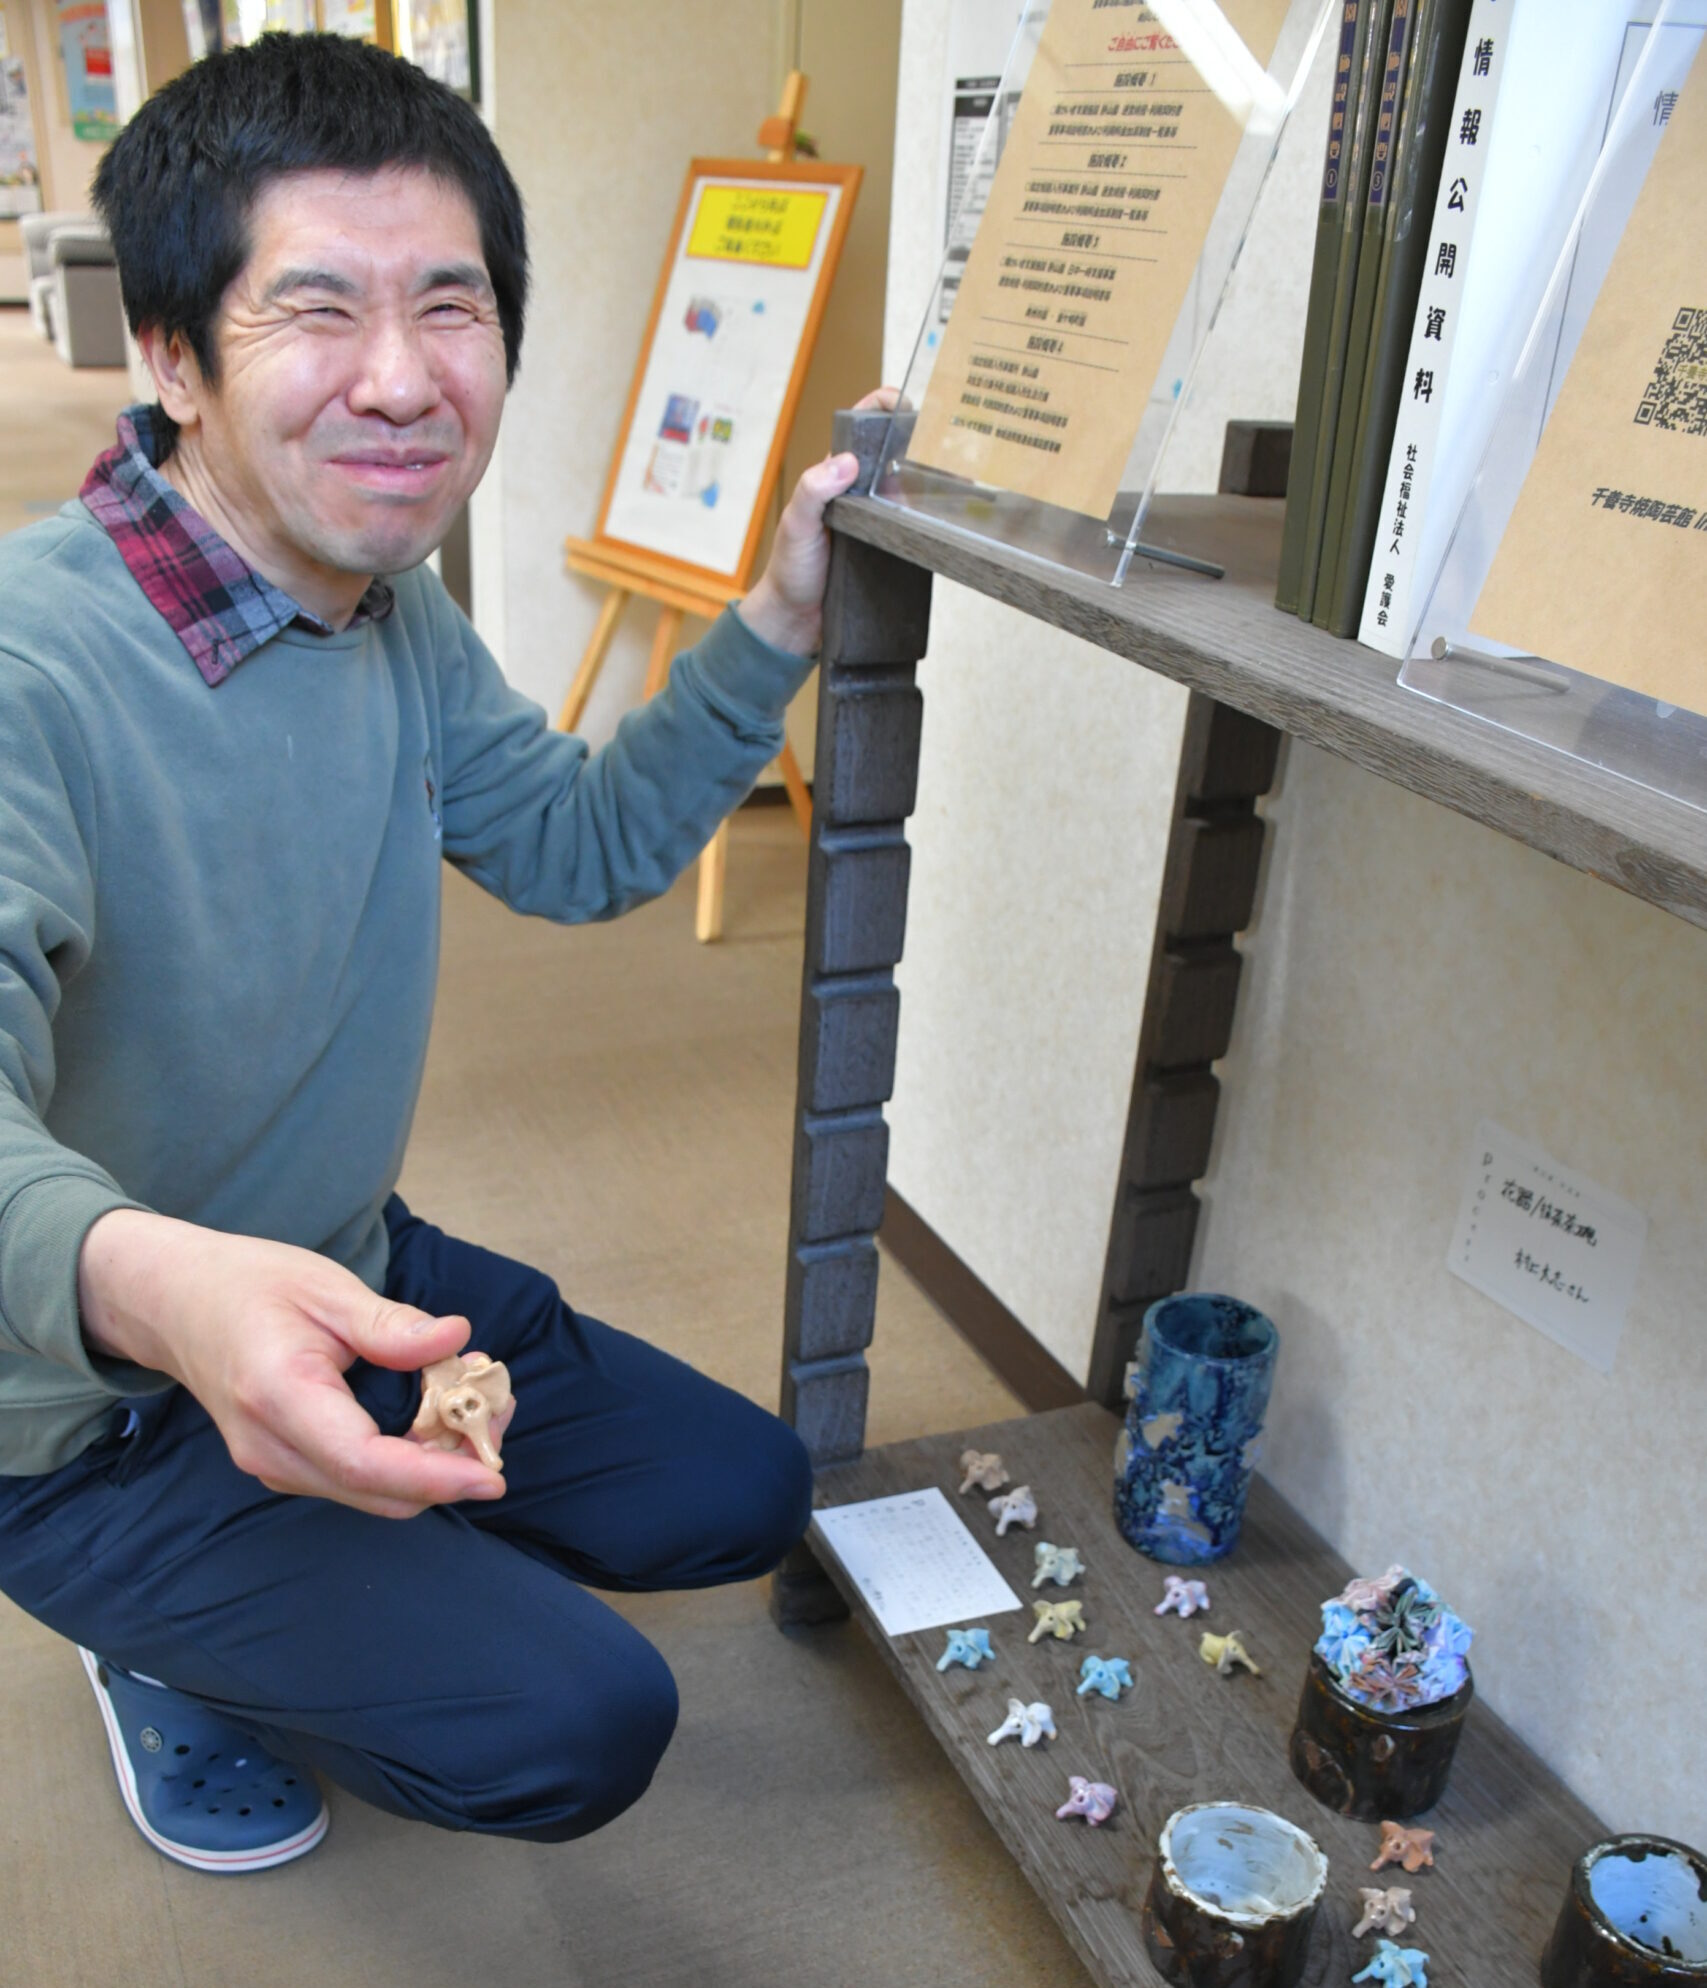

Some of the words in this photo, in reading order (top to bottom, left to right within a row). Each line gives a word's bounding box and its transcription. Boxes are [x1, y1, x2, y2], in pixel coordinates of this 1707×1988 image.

[1413, 38, 1494, 403] 情報公開資料
[1389, 443, 1418, 555] 社会福祉法人
[1377, 573, 1395, 627] 愛護会
